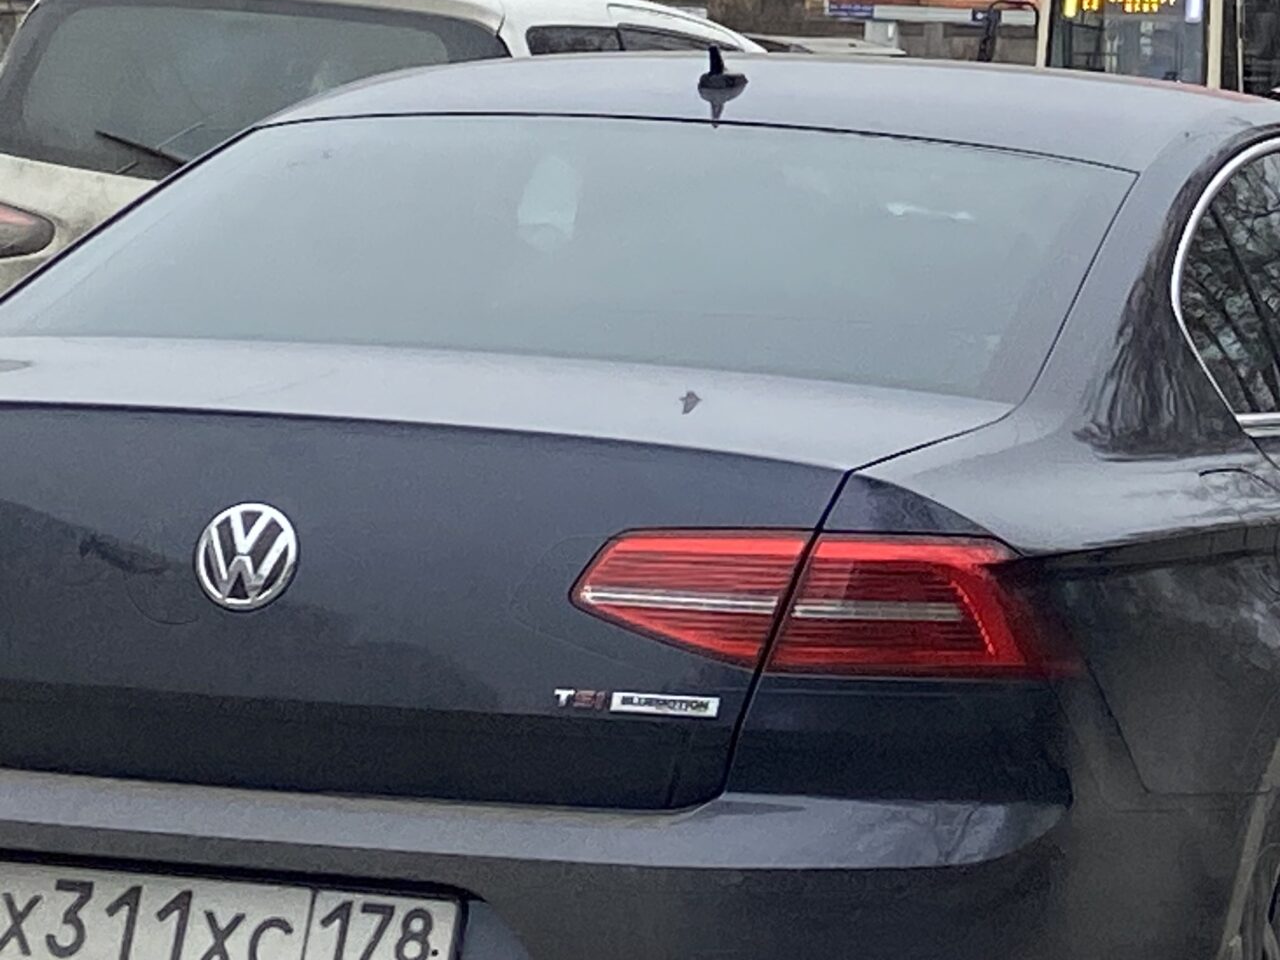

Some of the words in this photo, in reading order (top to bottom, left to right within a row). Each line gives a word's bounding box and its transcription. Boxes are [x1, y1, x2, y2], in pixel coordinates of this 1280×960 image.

[554, 689, 608, 711] TSI
[0, 878, 294, 960] Х311ХС
[320, 899, 434, 960] 178
